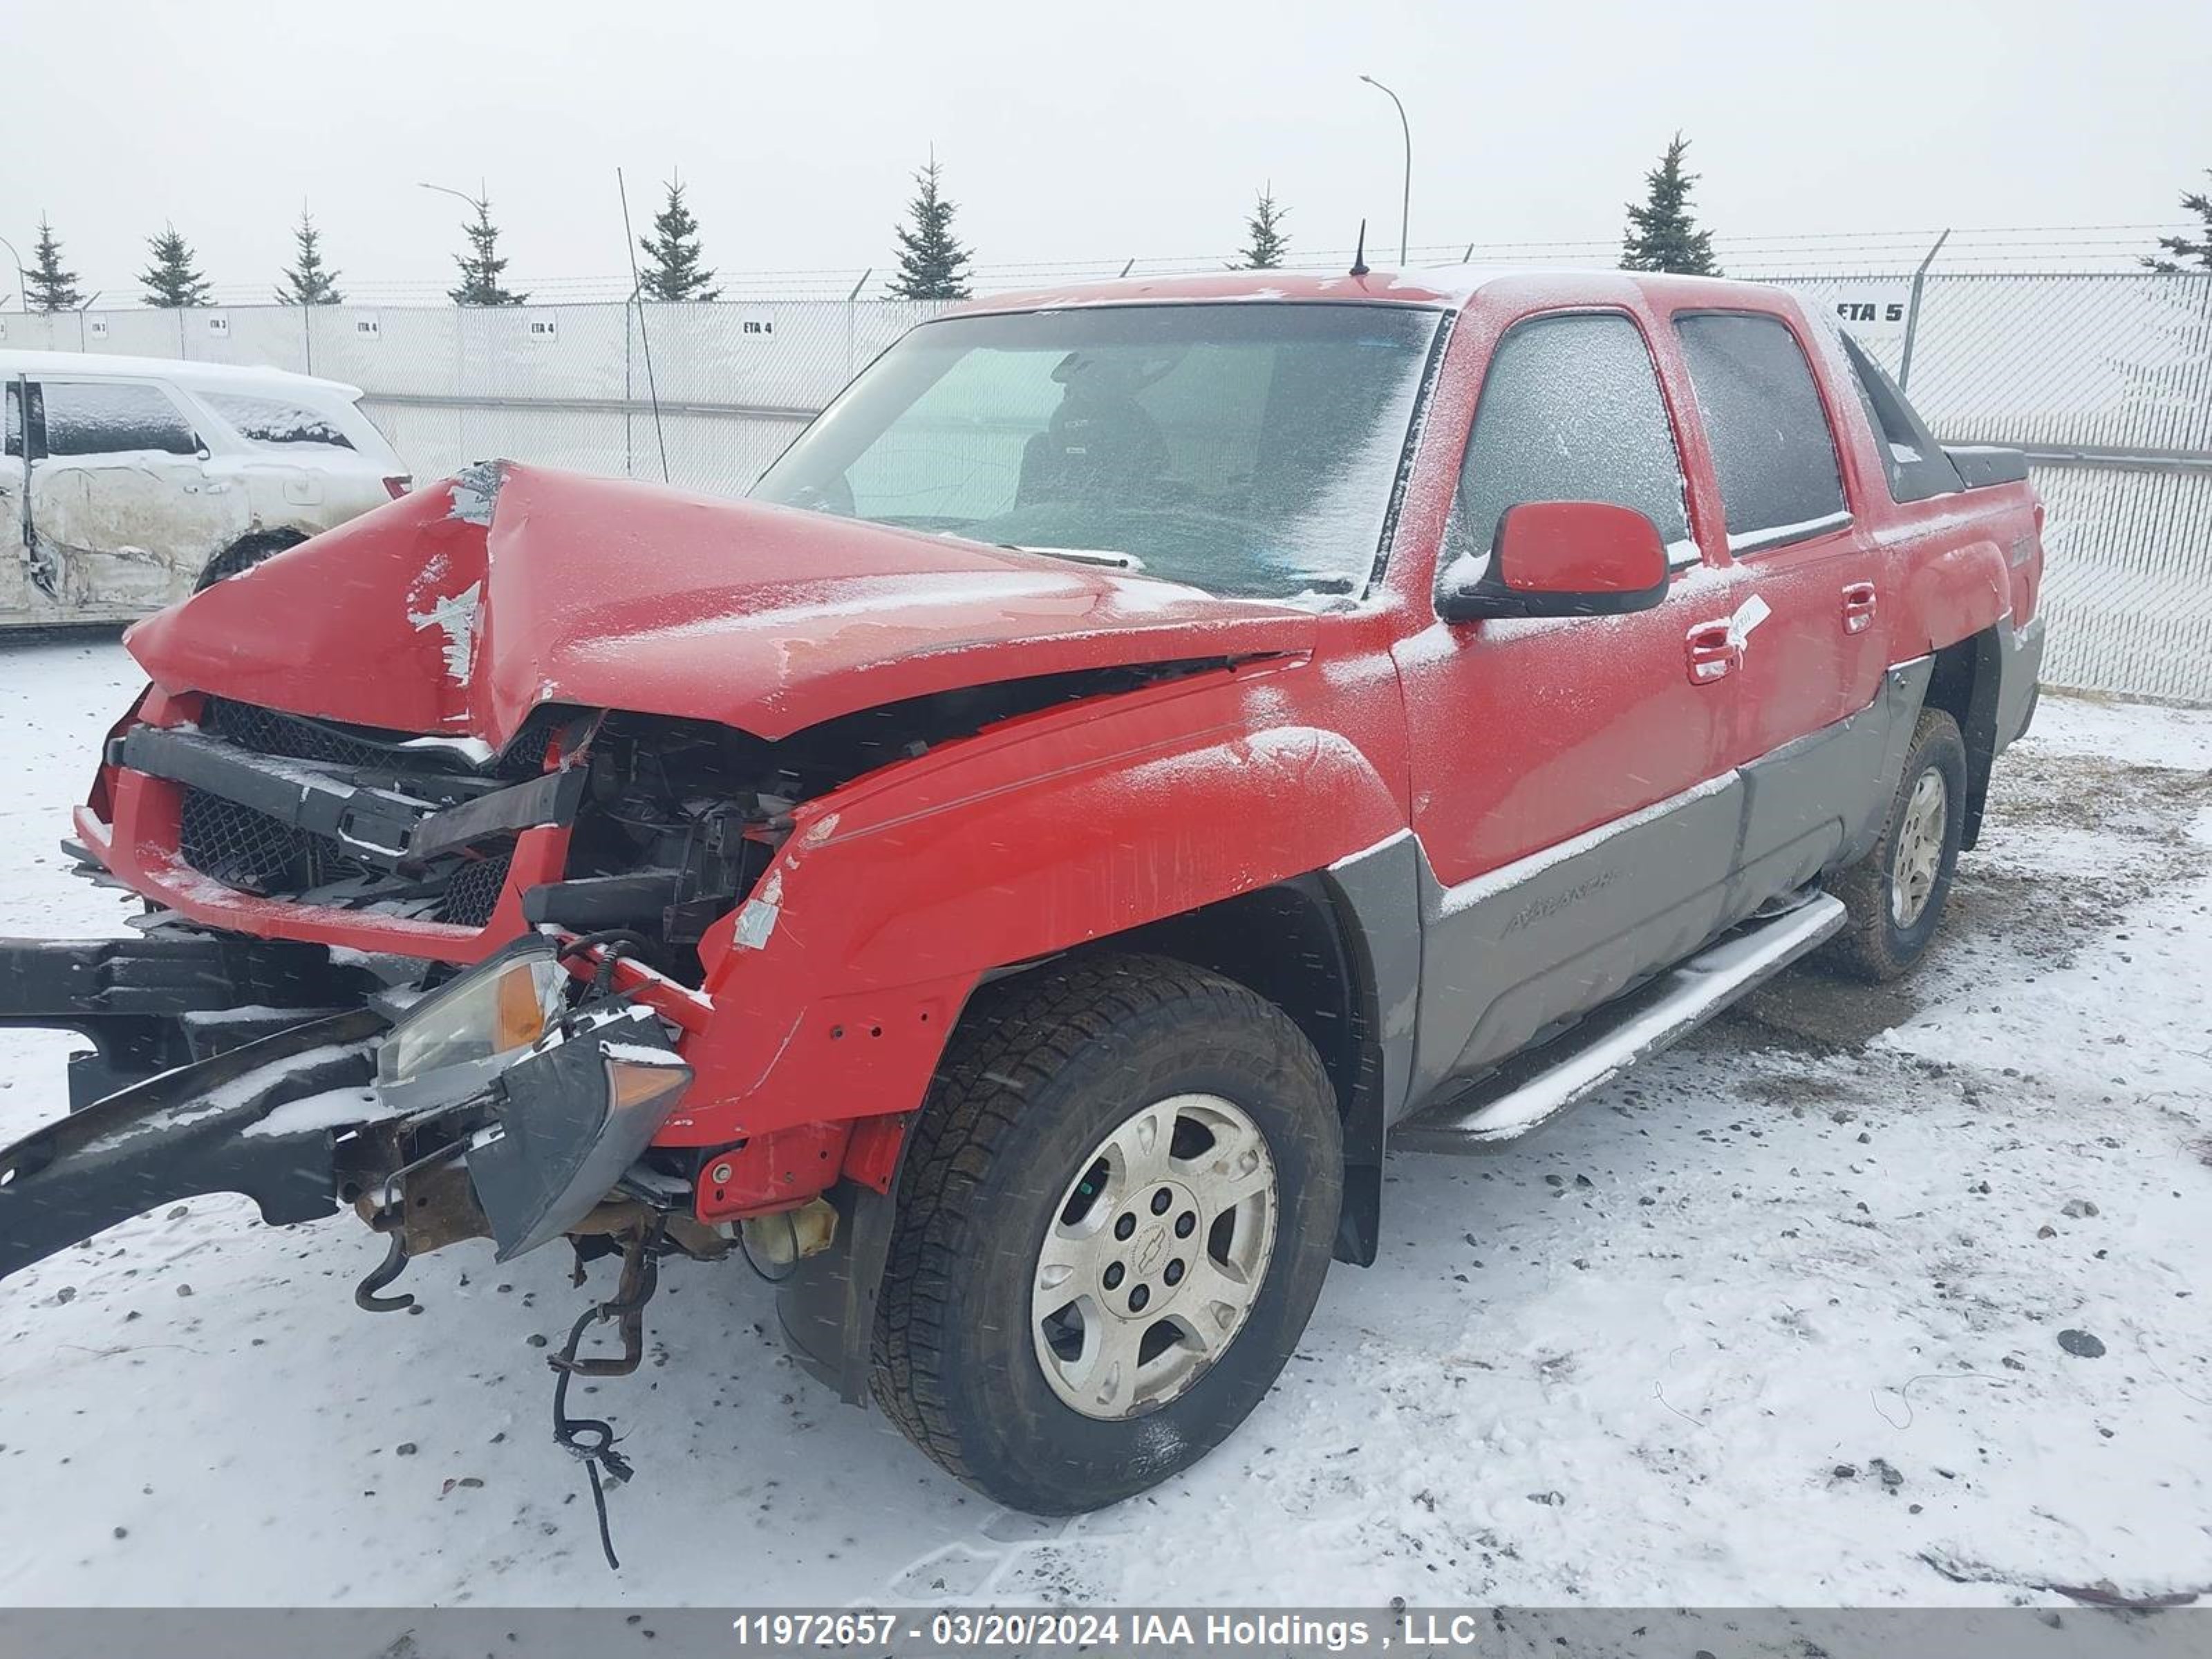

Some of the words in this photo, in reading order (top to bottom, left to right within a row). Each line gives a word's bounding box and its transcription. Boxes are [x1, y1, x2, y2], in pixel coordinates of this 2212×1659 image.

[1837, 303, 1876, 321] ETA
[1885, 303, 1904, 321] 5
[532, 322, 545, 333] ETA
[548, 322, 554, 333] 4
[744, 321, 761, 333] ETA
[765, 321, 771, 334] 4
